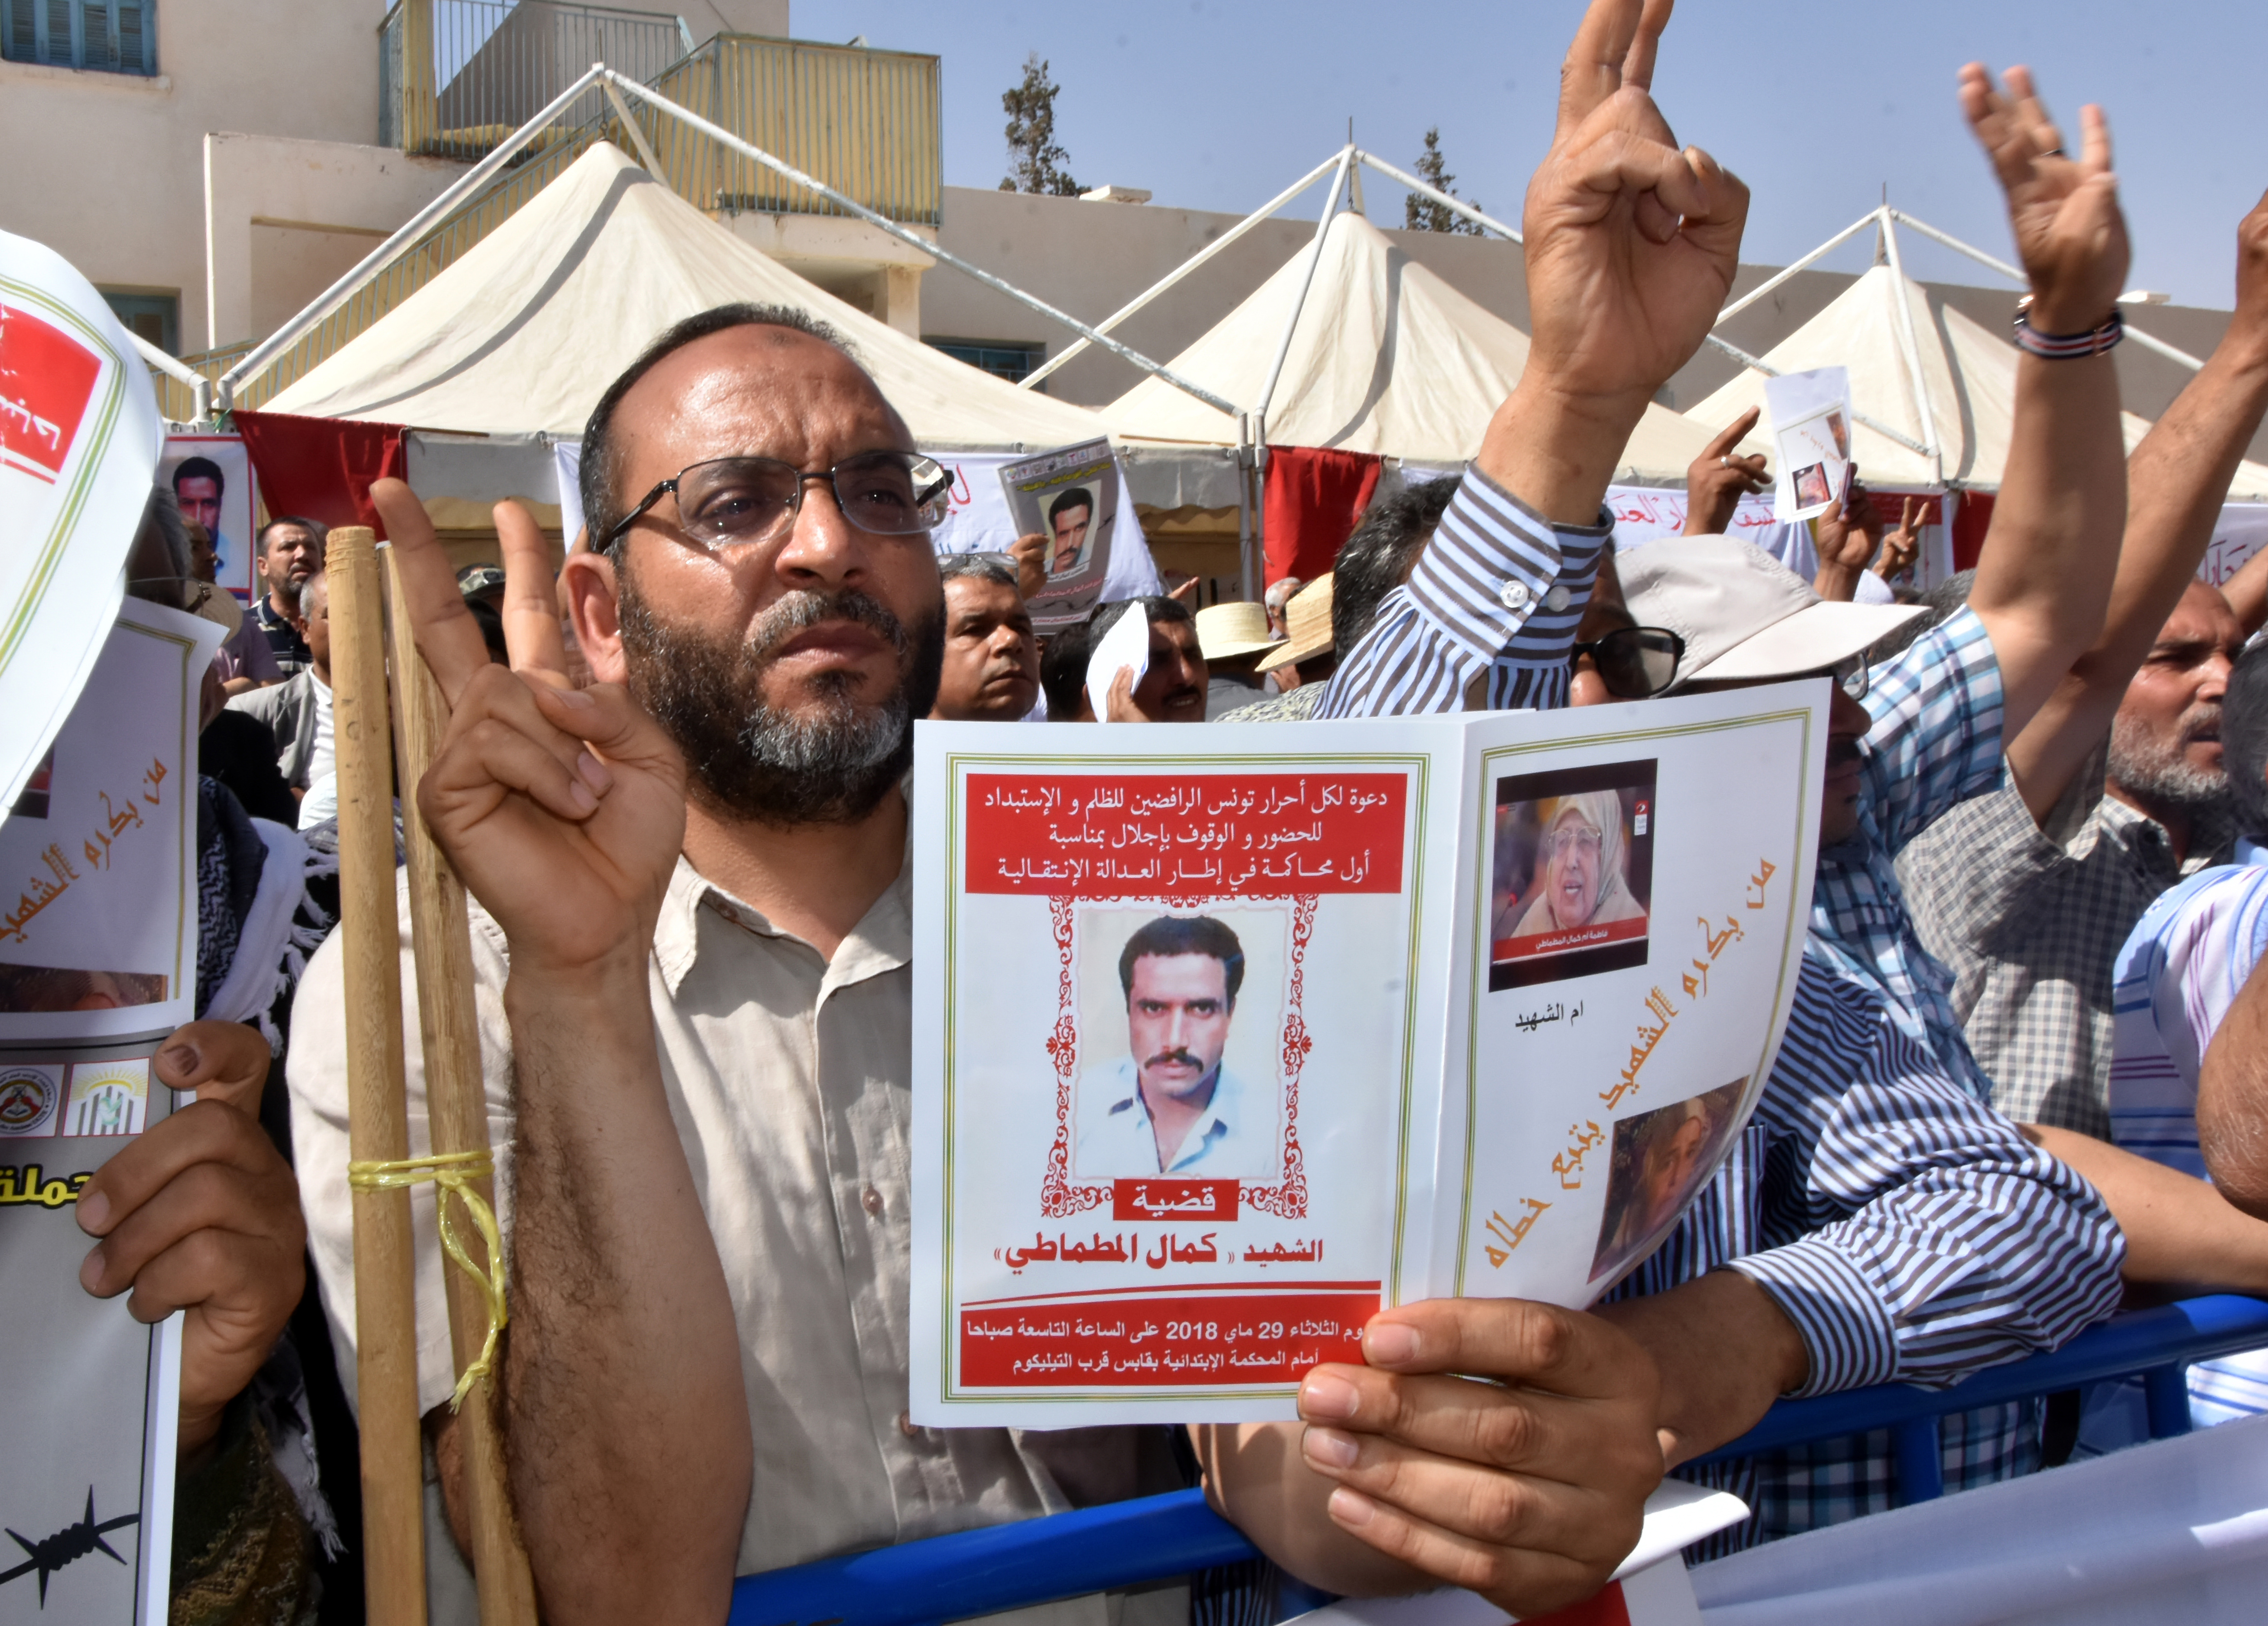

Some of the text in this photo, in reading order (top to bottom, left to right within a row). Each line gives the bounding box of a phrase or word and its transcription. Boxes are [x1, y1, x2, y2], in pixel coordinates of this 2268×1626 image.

[0, 395, 61, 451] باحا
[145, 760, 167, 804] من
[986, 779, 1387, 821] دعوة لكل أحرار تونس الرافضين للظلم و الإستبداد
[85, 793, 143, 867] يكرم
[1049, 822, 1321, 852] للحضور و الوقوف بإجلال بمناسبة
[999, 849, 1369, 892] أول محاكمة في إطار العدالة الإنتقالية
[1535, 936, 1567, 951] المطماطي
[1566, 934, 1581, 945] كمال
[1516, 999, 1584, 1031] ام الشهيد
[1484, 858, 1777, 1269] من يكرم الشهيد يتبع خطاه
[1133, 1185, 1215, 1217] قضية
[1147, 1234, 1217, 1269] كمال
[1244, 1239, 1323, 1267] الشهيد
[967, 1318, 1363, 1343] وم الثلاثاء 29 ماي 2018 على الساعة التاسعة صباحا
[1014, 1347, 1318, 1374] أمام المحكمة الإبتدائية بقابس قرب التيليكوم
